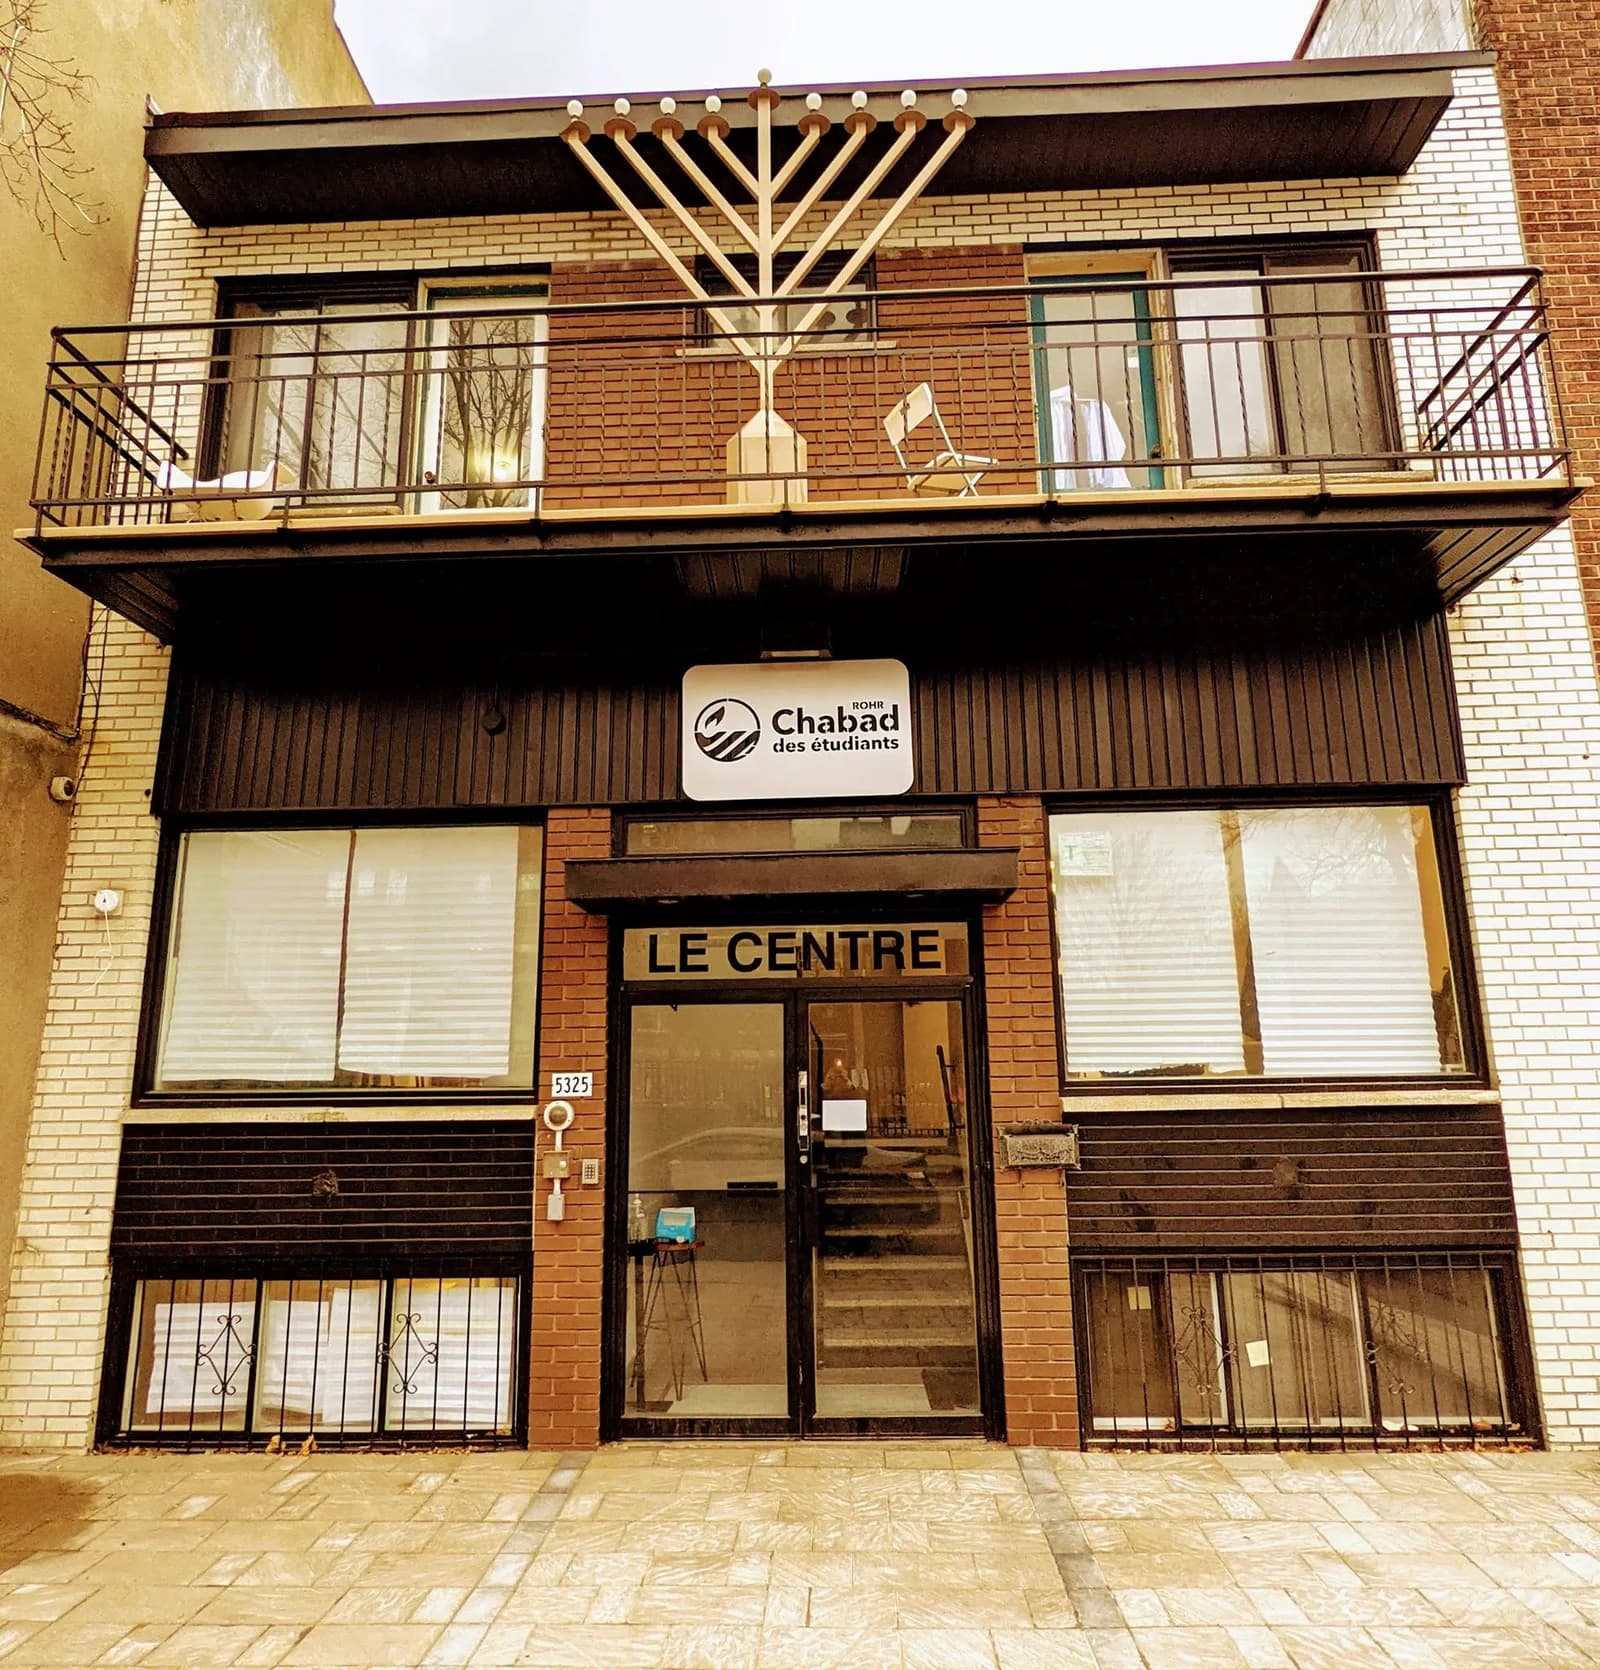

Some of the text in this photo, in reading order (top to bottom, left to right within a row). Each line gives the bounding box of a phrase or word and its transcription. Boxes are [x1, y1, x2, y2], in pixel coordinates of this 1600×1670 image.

[852, 701, 885, 711] ROHR
[771, 704, 900, 736] Chabad
[773, 735, 900, 753] des étudiants
[648, 929, 942, 973] LE CENTRE
[555, 1076, 589, 1094] 5325
